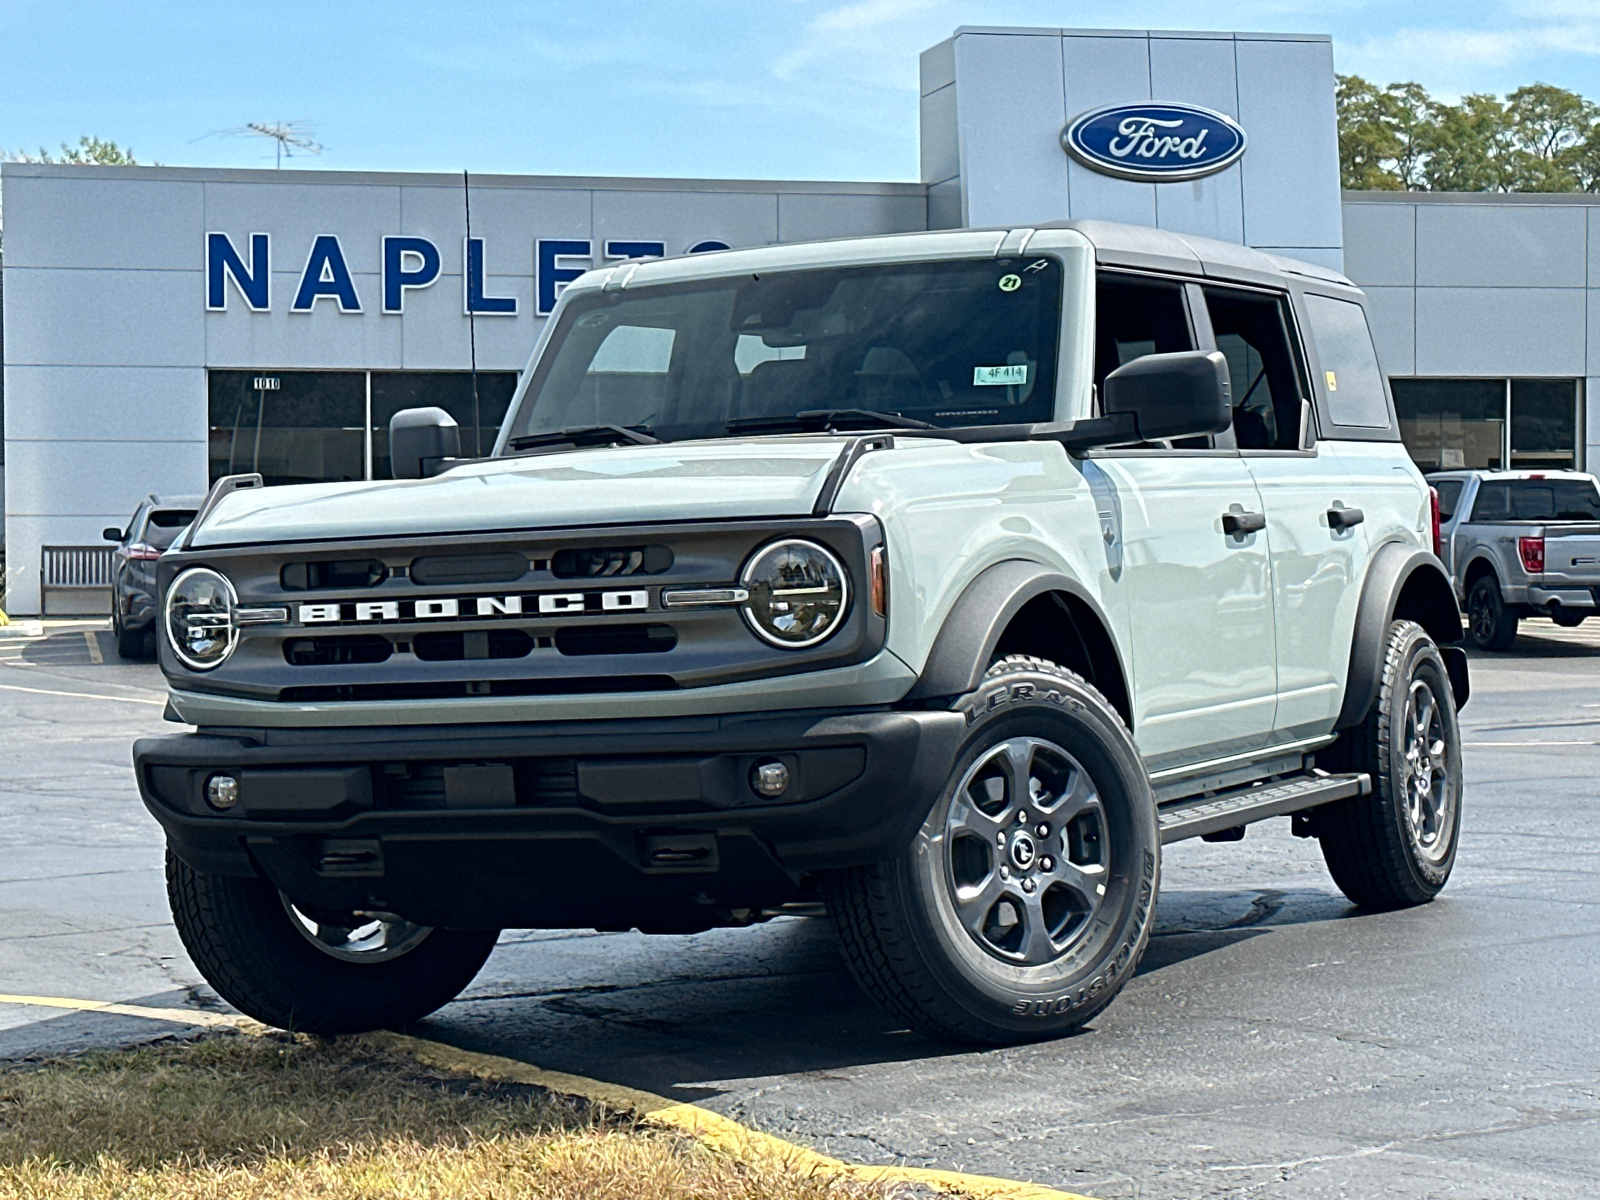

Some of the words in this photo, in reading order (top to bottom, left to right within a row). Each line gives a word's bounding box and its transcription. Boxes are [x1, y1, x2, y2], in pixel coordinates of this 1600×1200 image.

[1109, 117, 1208, 159] Ford
[205, 231, 733, 316] NAPLE
[1001, 277, 1018, 288] 21
[255, 377, 280, 390] 1010
[299, 590, 649, 623] BRONCO
[1043, 690, 1088, 713] A/T
[1012, 846, 1155, 1017] BRIDGESTONE
